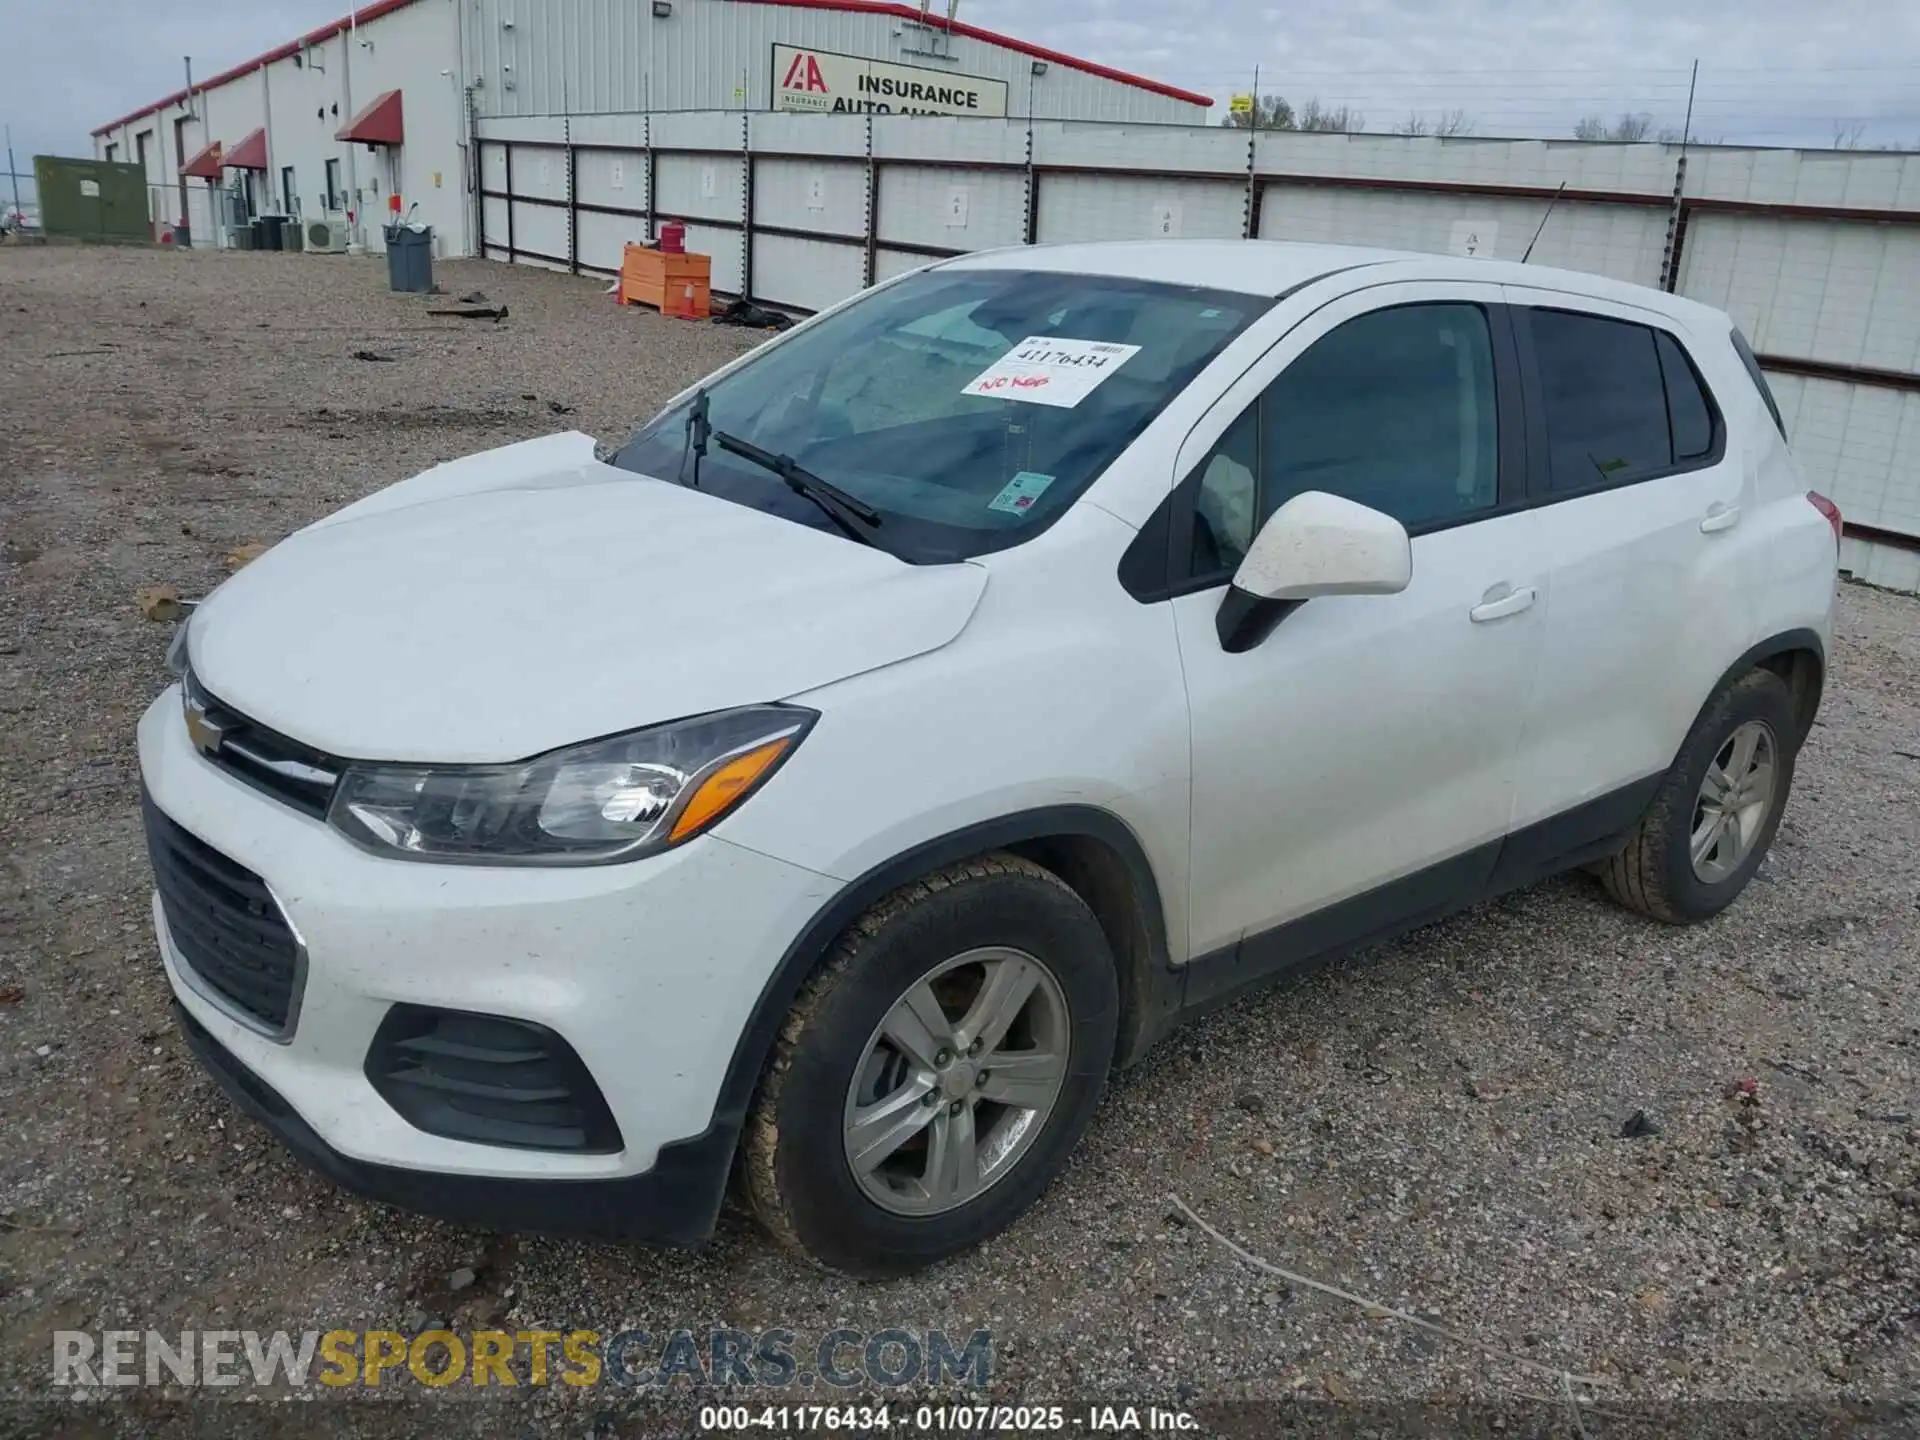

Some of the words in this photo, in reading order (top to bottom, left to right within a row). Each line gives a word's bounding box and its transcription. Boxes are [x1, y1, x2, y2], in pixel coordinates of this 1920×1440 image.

[858, 75, 978, 108] INSURANCE
[1018, 350, 1108, 368] 41176434
[978, 376, 1007, 391] NO
